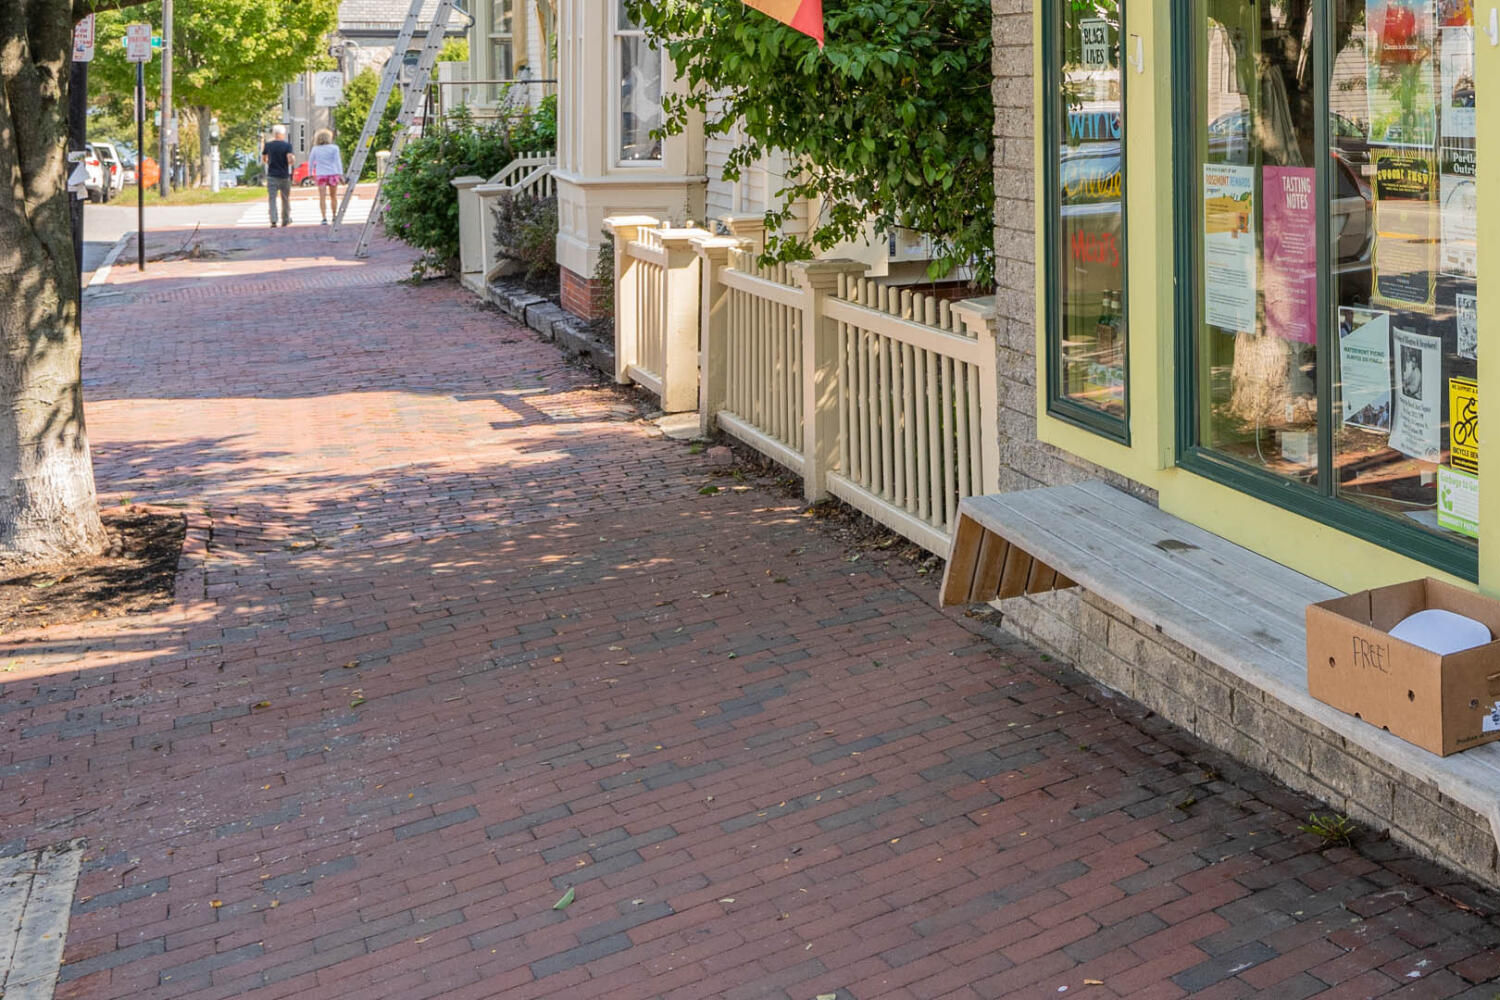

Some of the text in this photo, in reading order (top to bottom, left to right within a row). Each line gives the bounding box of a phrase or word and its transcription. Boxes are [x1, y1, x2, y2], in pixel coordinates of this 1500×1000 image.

[1083, 27, 1105, 45] BLACK
[1086, 48, 1104, 65] LIVES
[1453, 152, 1476, 163] Portl
[1453, 163, 1476, 174] Outri
[1064, 164, 1121, 198] Cheese
[1282, 175, 1311, 193] TASTING
[1286, 193, 1309, 210] NOTES
[1071, 229, 1119, 268] Meats
[1452, 446, 1469, 457] BICYCLE
[1352, 635, 1393, 675] FREE!
